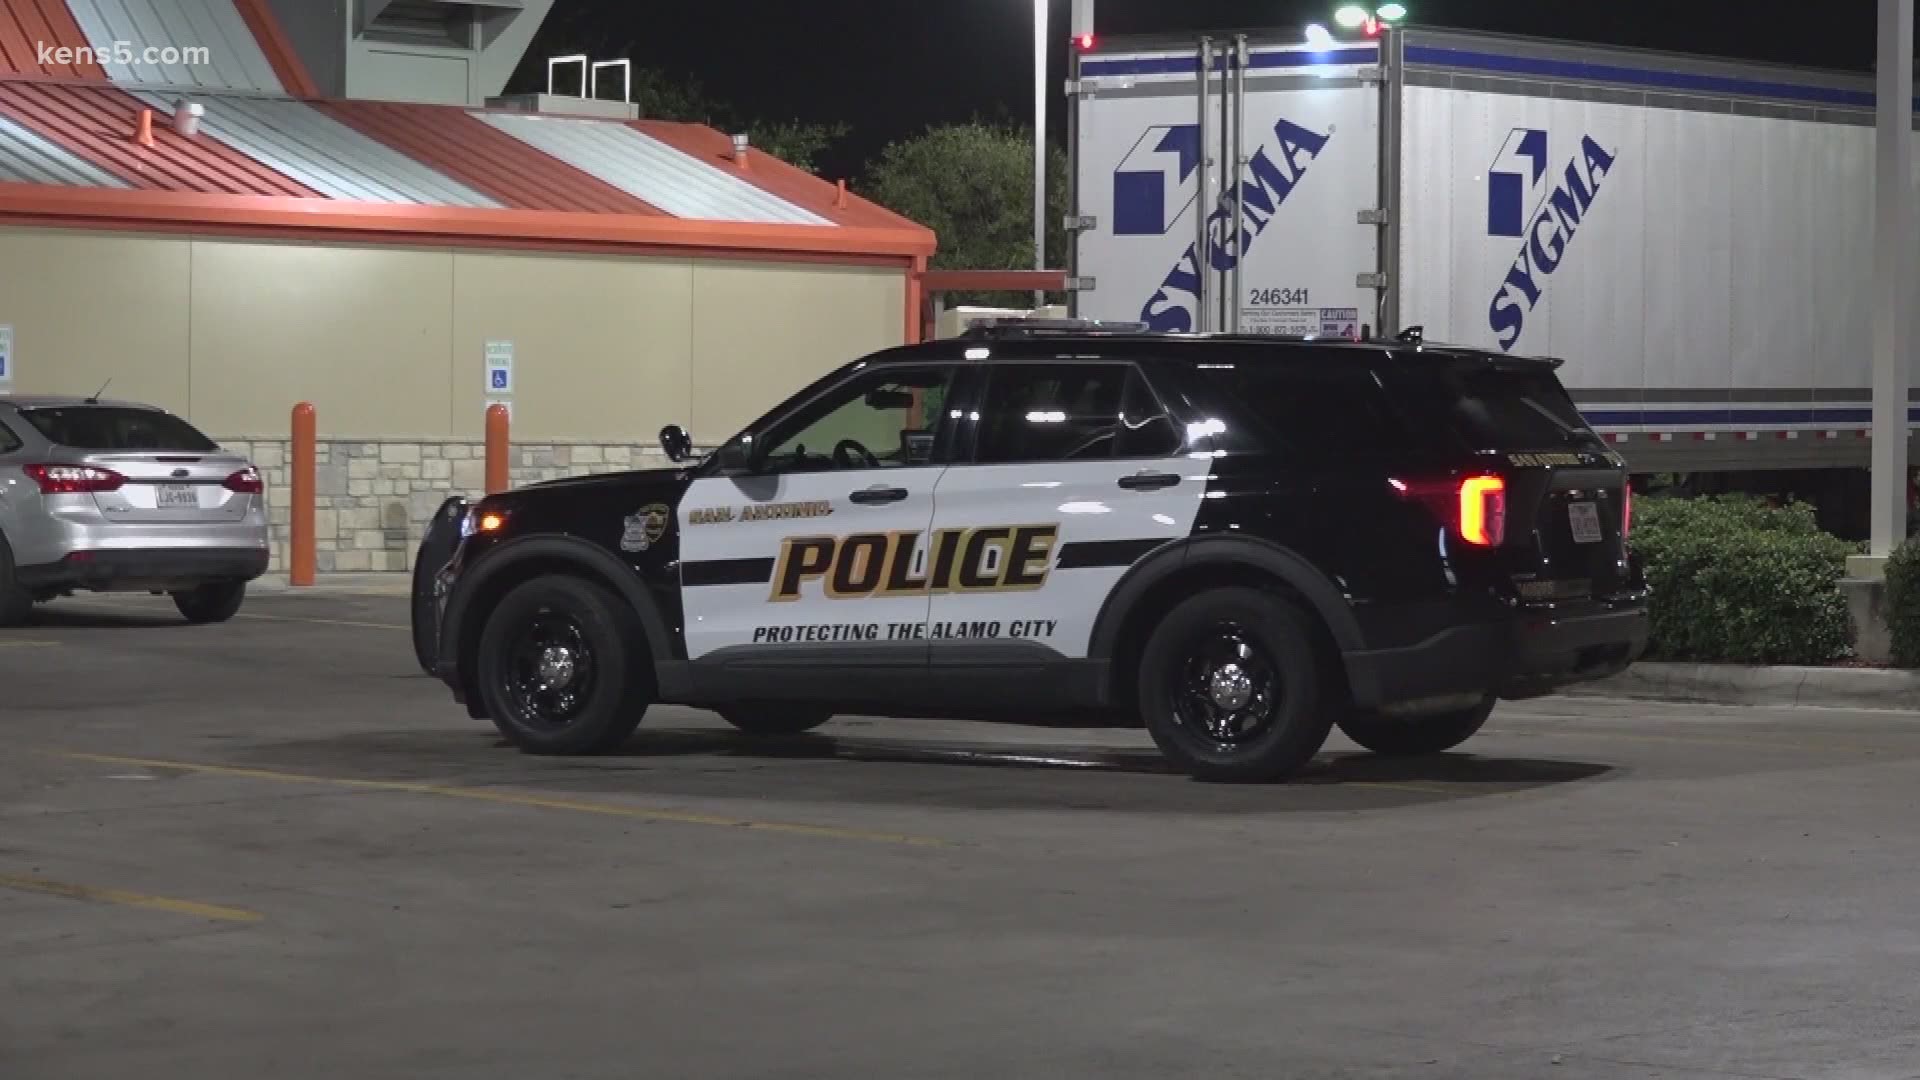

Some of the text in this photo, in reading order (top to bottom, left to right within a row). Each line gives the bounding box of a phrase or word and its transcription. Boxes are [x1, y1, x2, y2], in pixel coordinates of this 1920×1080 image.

[1140, 118, 1330, 333] SYGMA
[1489, 134, 1615, 352] SYGMA
[1250, 288, 1308, 305] 246341
[689, 500, 835, 524] SAN ANTONIO
[768, 522, 1061, 602] POLICE
[753, 619, 1058, 643] PROTECTING THE ALAMO CITY
